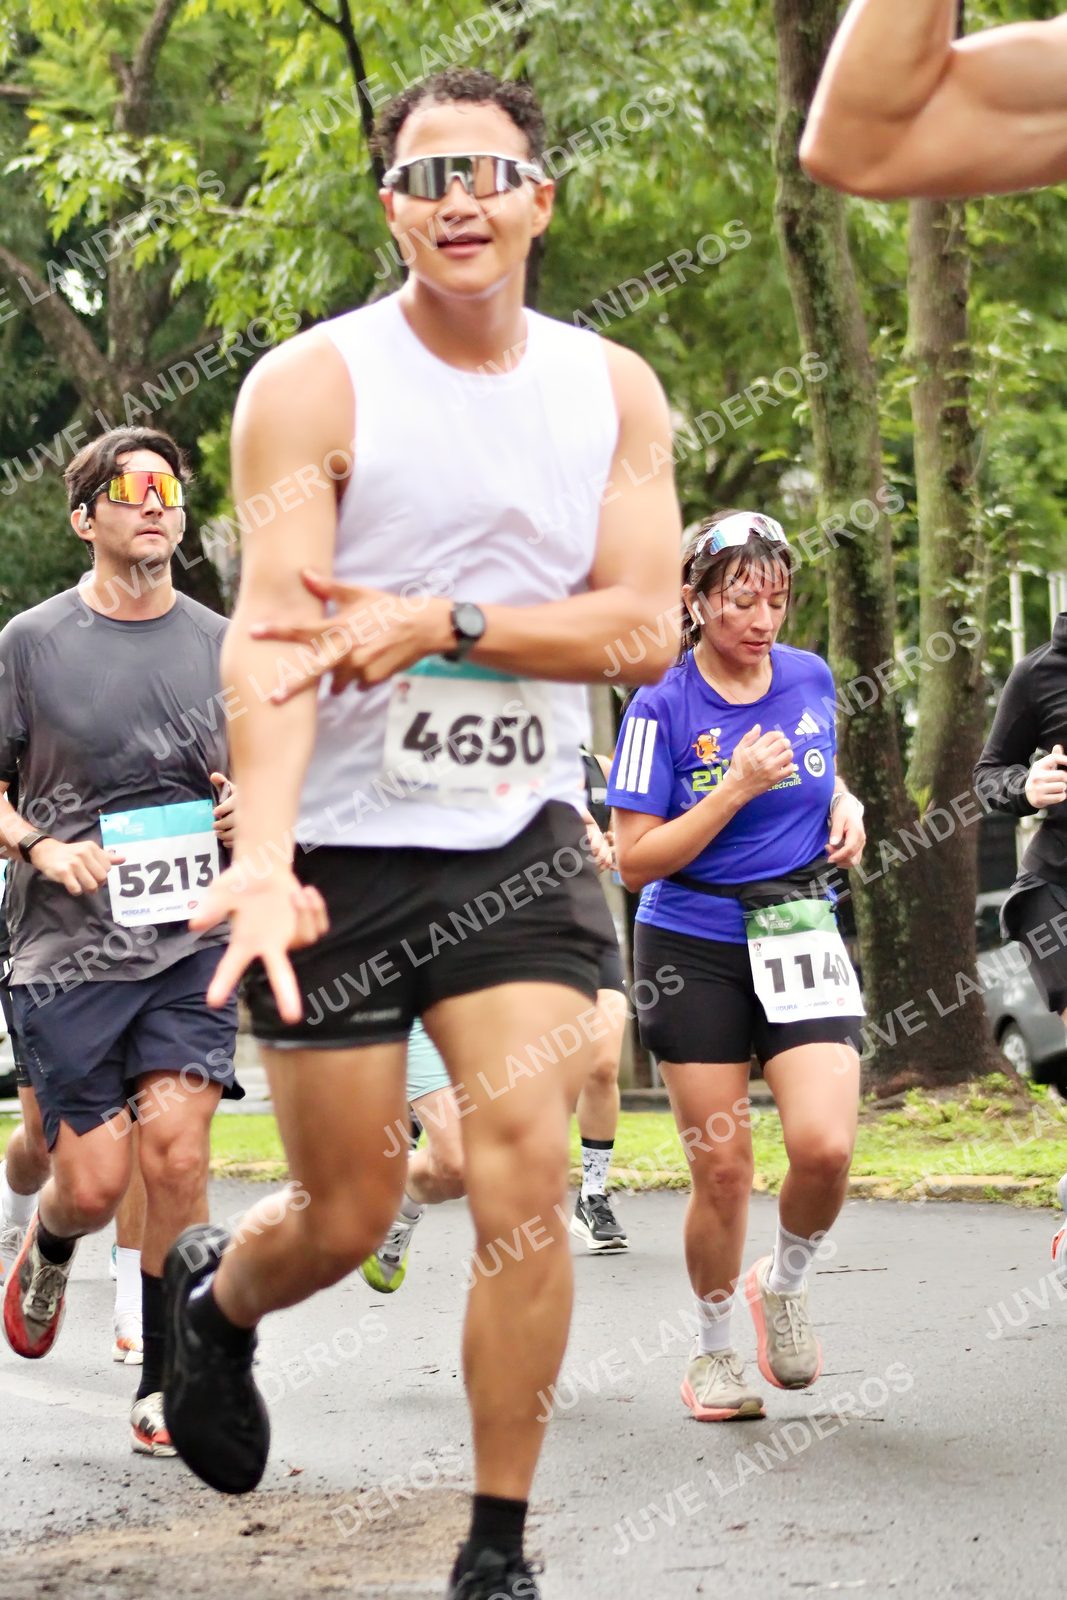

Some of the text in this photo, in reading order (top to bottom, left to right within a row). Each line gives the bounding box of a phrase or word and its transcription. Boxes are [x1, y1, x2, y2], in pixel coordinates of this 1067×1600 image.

[402, 712, 546, 766] 4650
[768, 776, 802, 791] lectrolit
[118, 853, 214, 898] 5213
[764, 951, 850, 994] 1140
